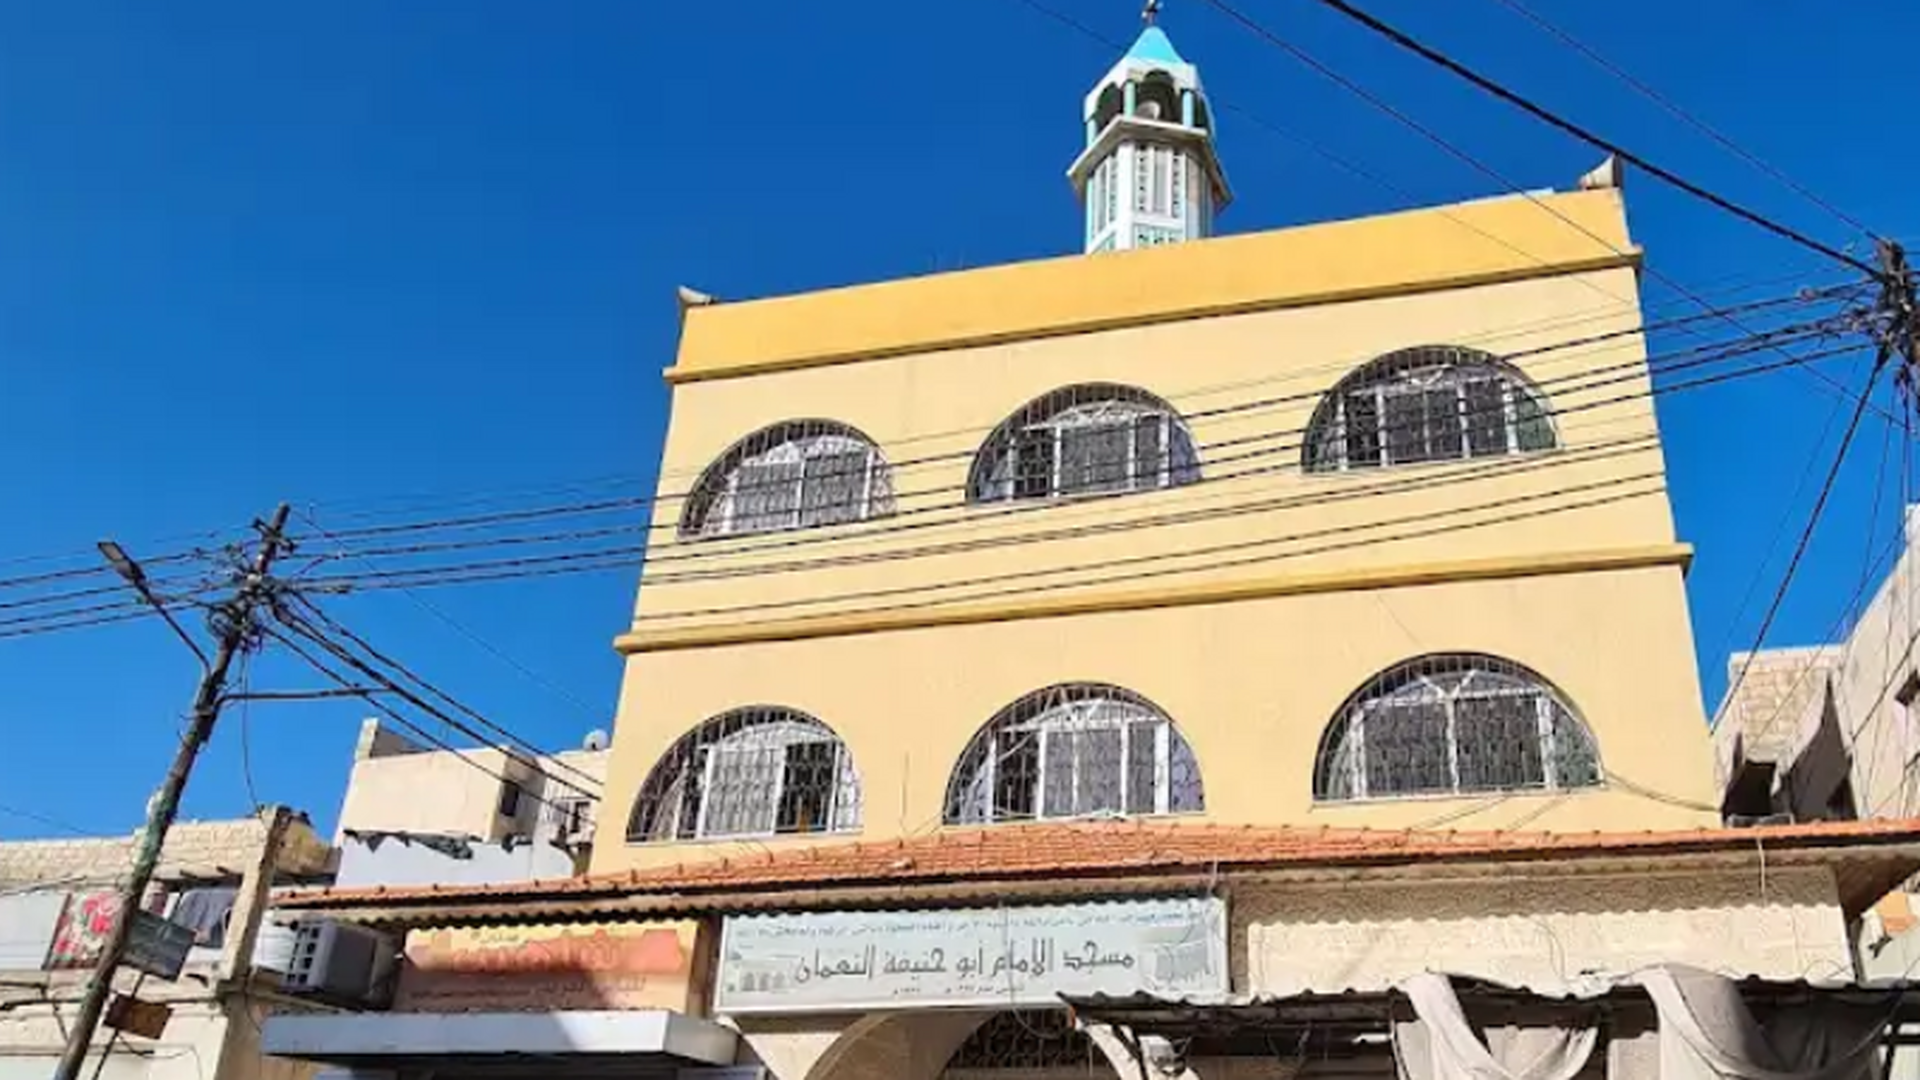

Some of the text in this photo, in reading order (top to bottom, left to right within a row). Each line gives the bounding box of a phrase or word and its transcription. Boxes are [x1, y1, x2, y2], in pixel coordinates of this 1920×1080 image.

[794, 942, 877, 984] النعمان
[882, 945, 947, 981] حنيفة
[1062, 938, 1136, 975] مسجد
